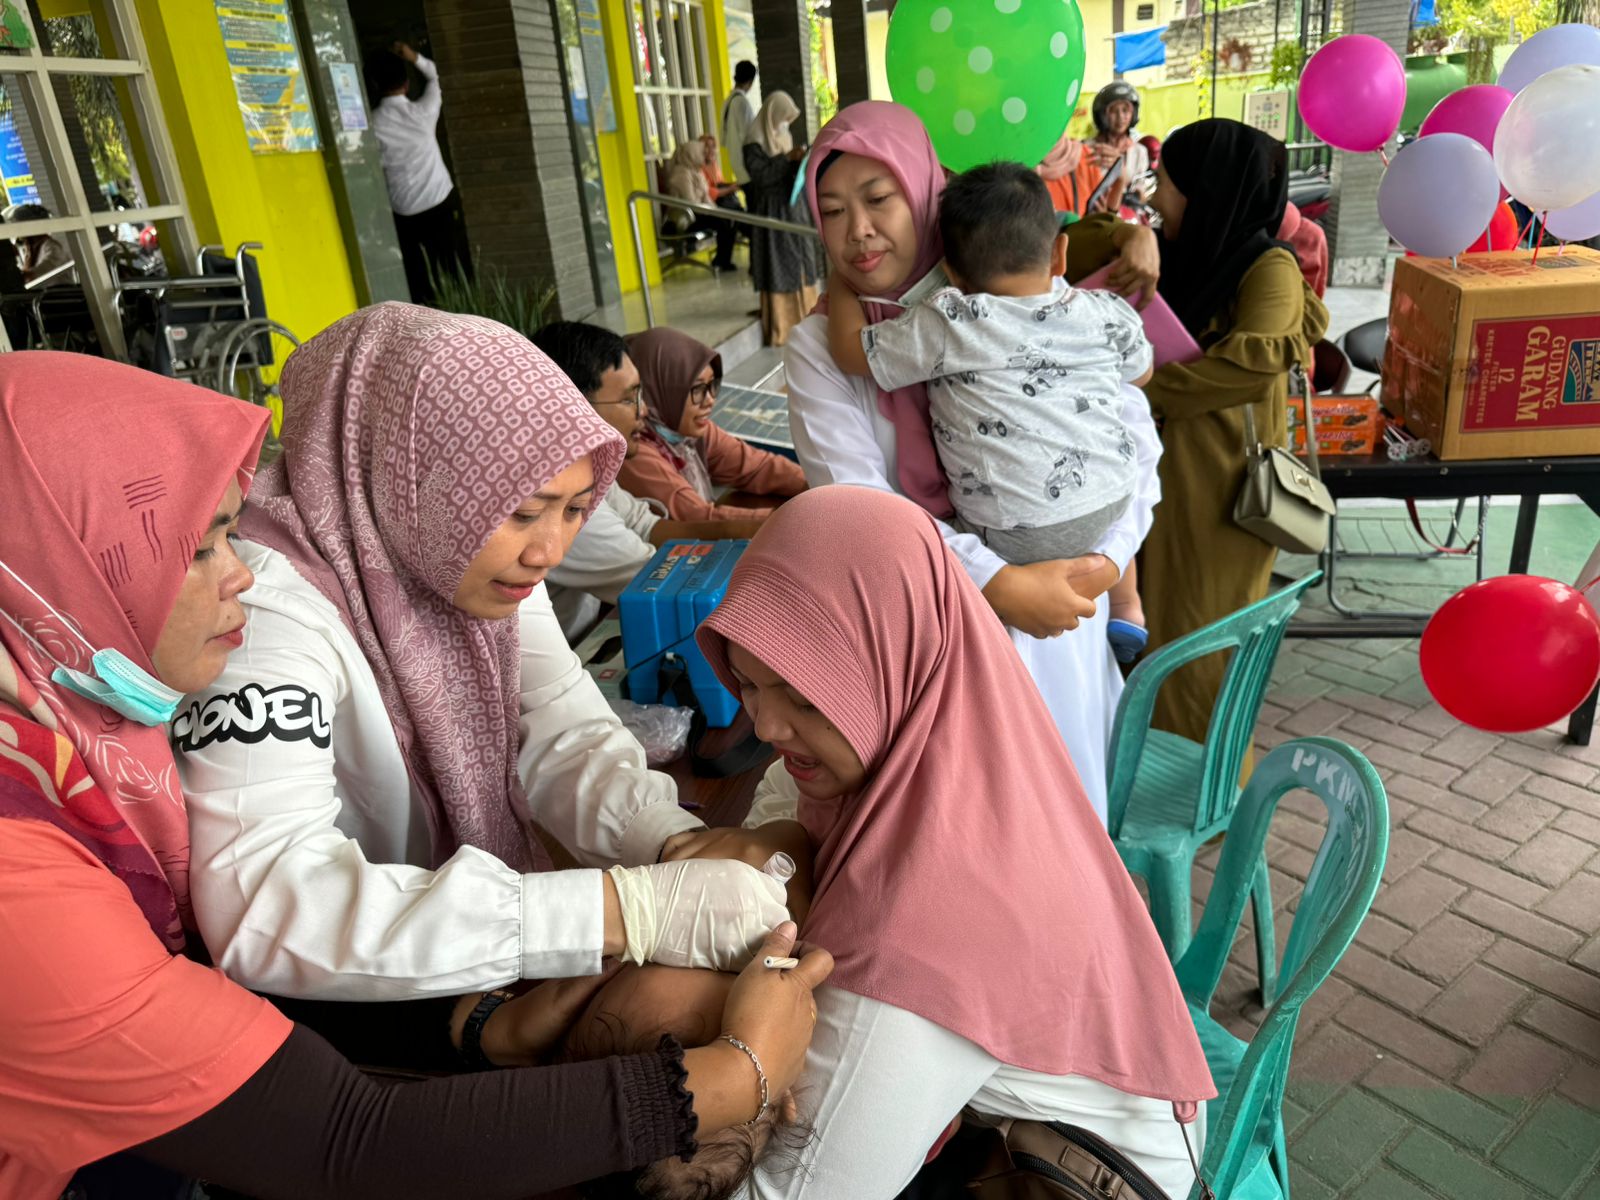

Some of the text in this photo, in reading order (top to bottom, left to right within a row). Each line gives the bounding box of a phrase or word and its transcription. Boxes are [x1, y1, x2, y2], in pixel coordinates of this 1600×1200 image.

[1475, 329, 1495, 423] KRETEK CIGARETTES
[1489, 361, 1500, 392] FILTER
[1498, 368, 1515, 384] 12
[1515, 325, 1551, 422] GARAM
[1542, 335, 1567, 410] GUDANG
